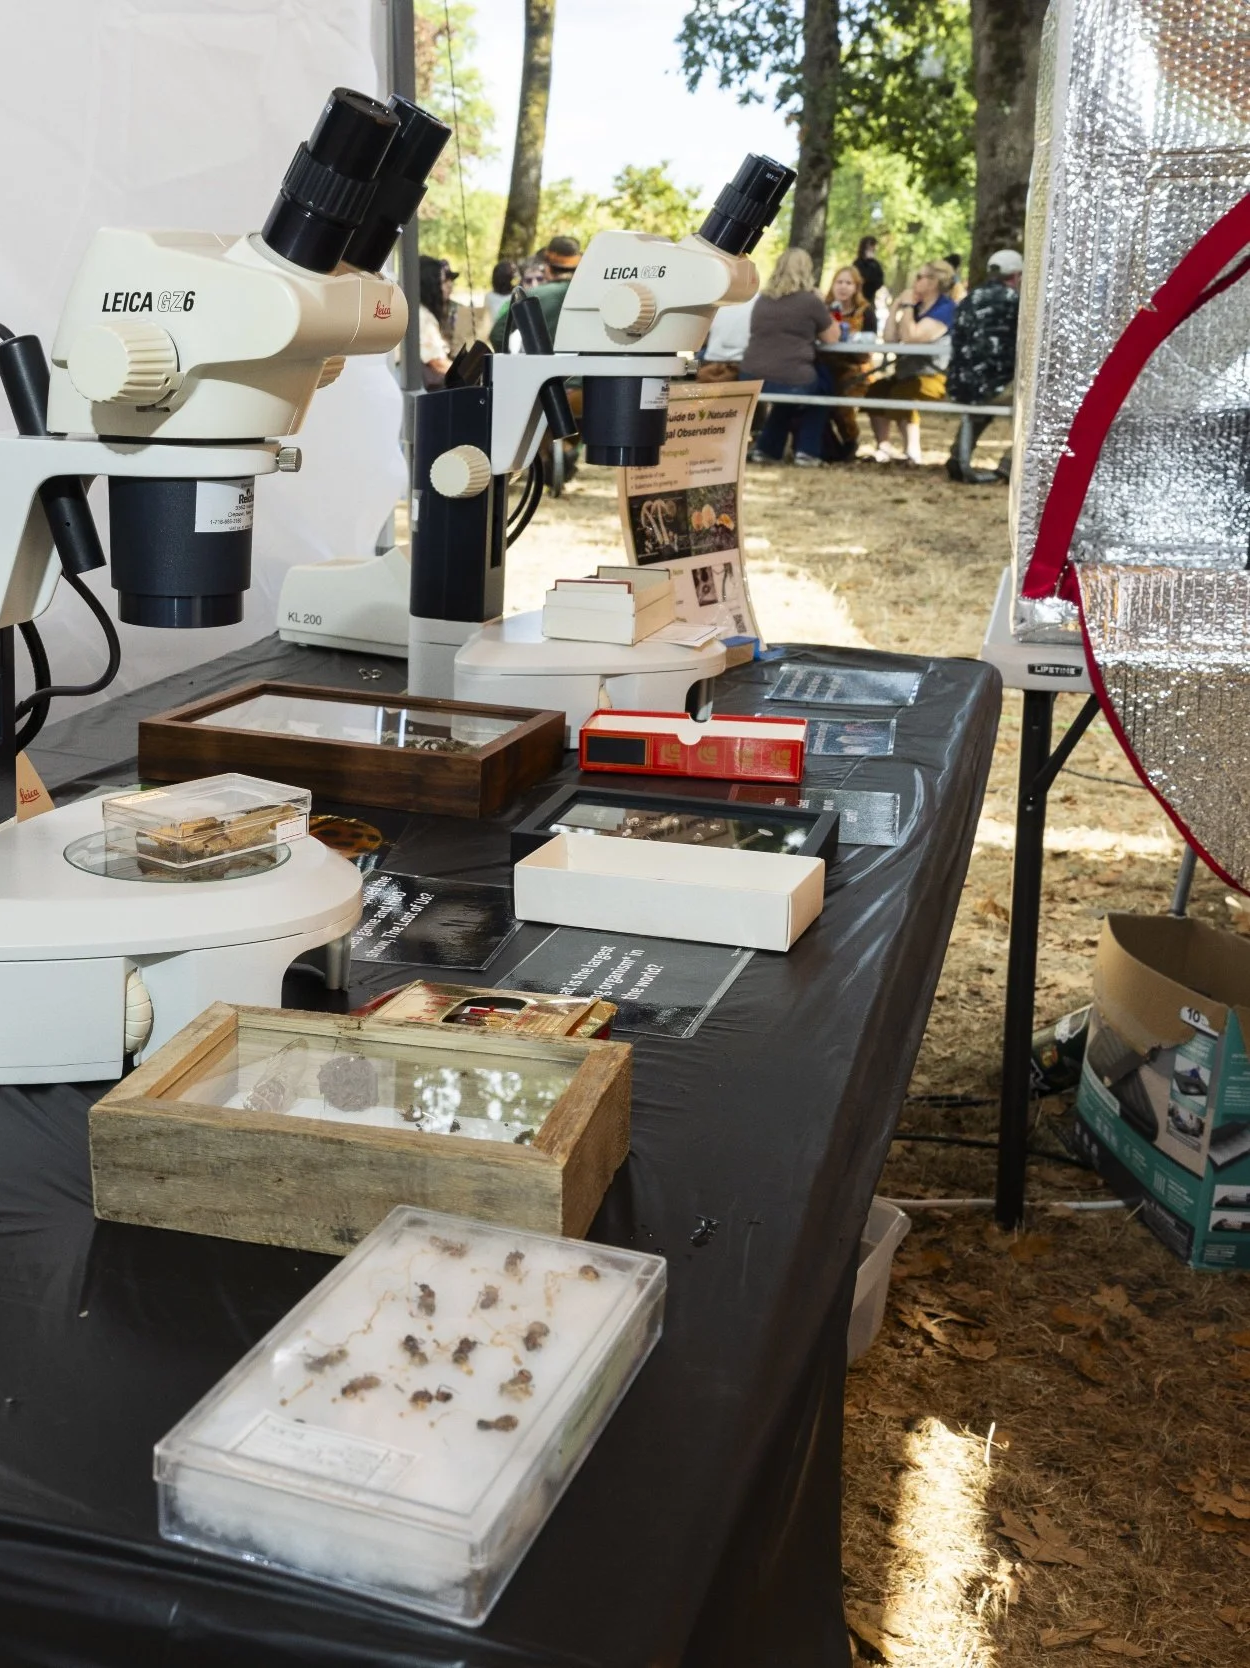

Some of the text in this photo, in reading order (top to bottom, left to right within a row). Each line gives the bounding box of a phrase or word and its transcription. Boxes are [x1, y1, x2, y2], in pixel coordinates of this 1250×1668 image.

[603, 266, 638, 280] LEICA
[101, 290, 196, 312] LEICA GZ6
[373, 299, 392, 319] Leica
[667, 412, 686, 422] uide
[687, 412, 696, 421] to
[677, 424, 726, 438] Observations
[288, 611, 322, 626] KL 200
[19, 787, 41, 804] Leica
[382, 891, 407, 906] HBO
[374, 905, 393, 918] and
[356, 918, 381, 937] game
[365, 892, 435, 958] show, The Last of Us?
[581, 945, 617, 967] largest
[571, 968, 594, 980] the
[621, 963, 664, 1000] the world?
[1187, 1008, 1201, 1022] 10
